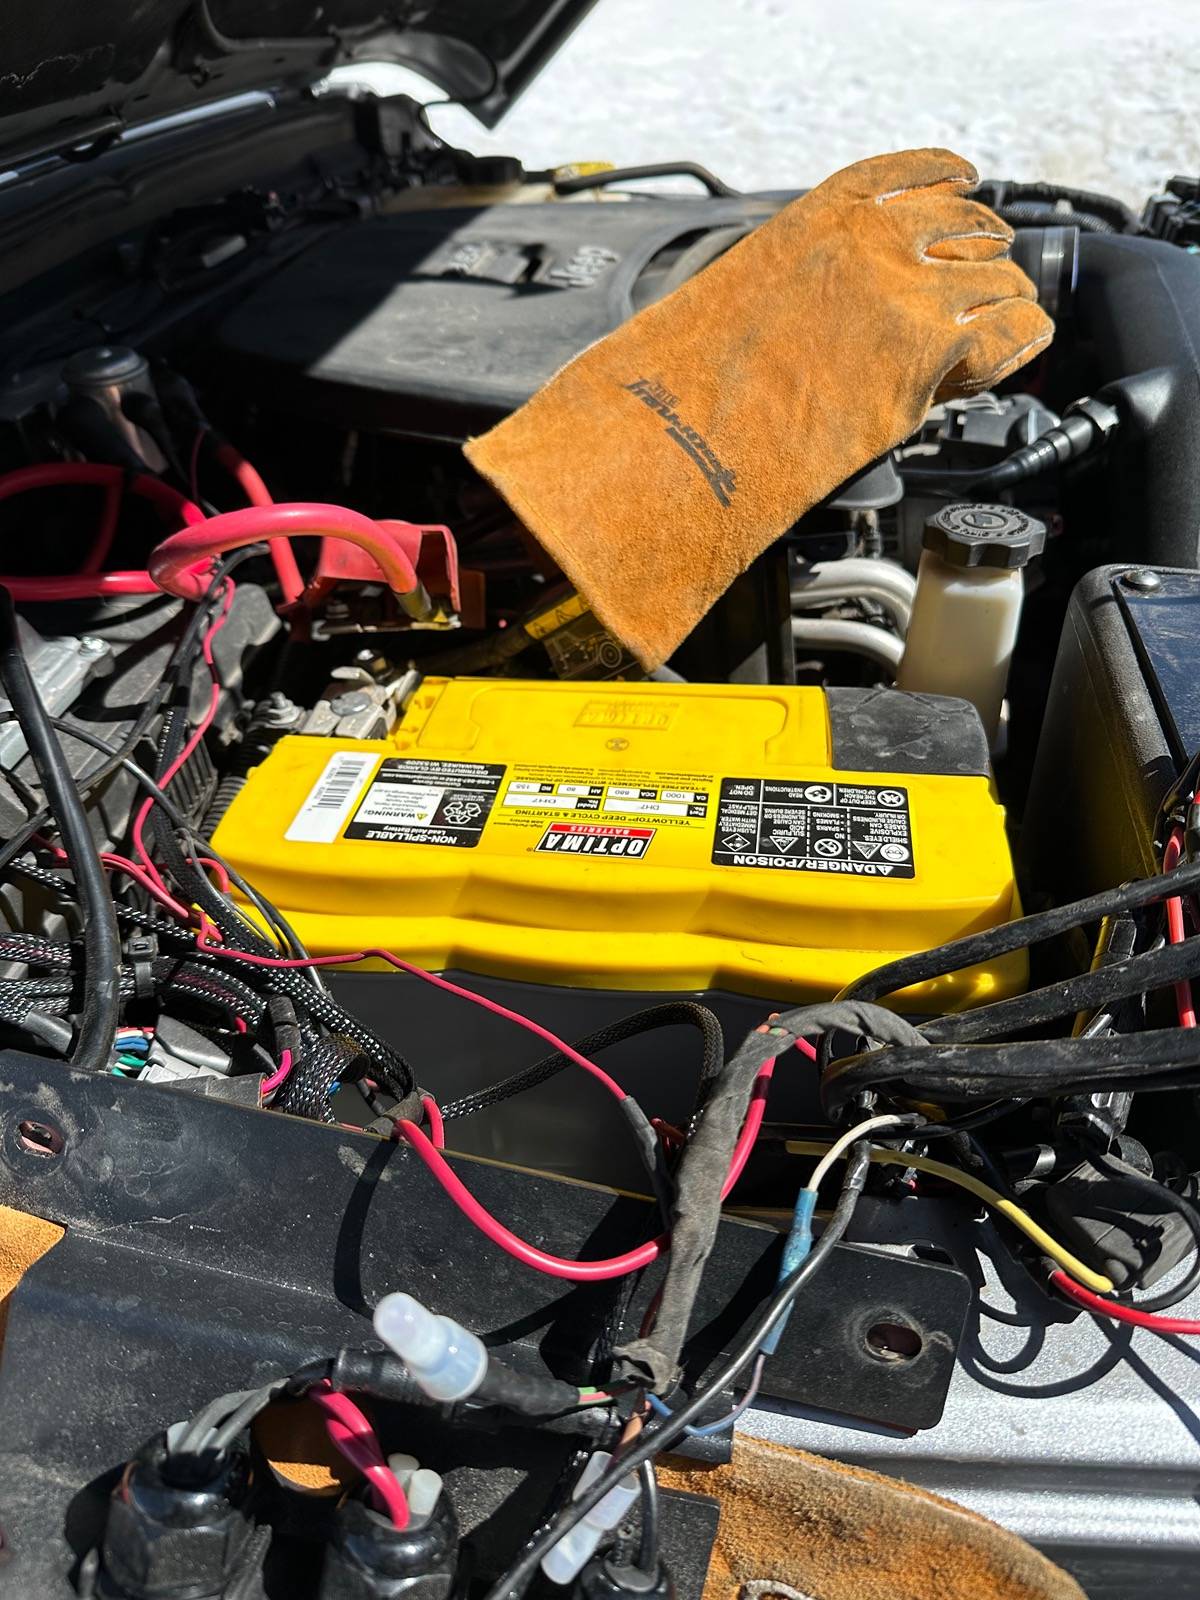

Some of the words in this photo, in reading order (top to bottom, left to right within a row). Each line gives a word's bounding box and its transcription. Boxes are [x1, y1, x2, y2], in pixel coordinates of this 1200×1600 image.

[366, 830, 457, 844] NON-SPILLABLE
[570, 826, 630, 835] BATTERIES
[545, 833, 644, 855] OPTIMA
[734, 855, 876, 874] DANGER/POISON
